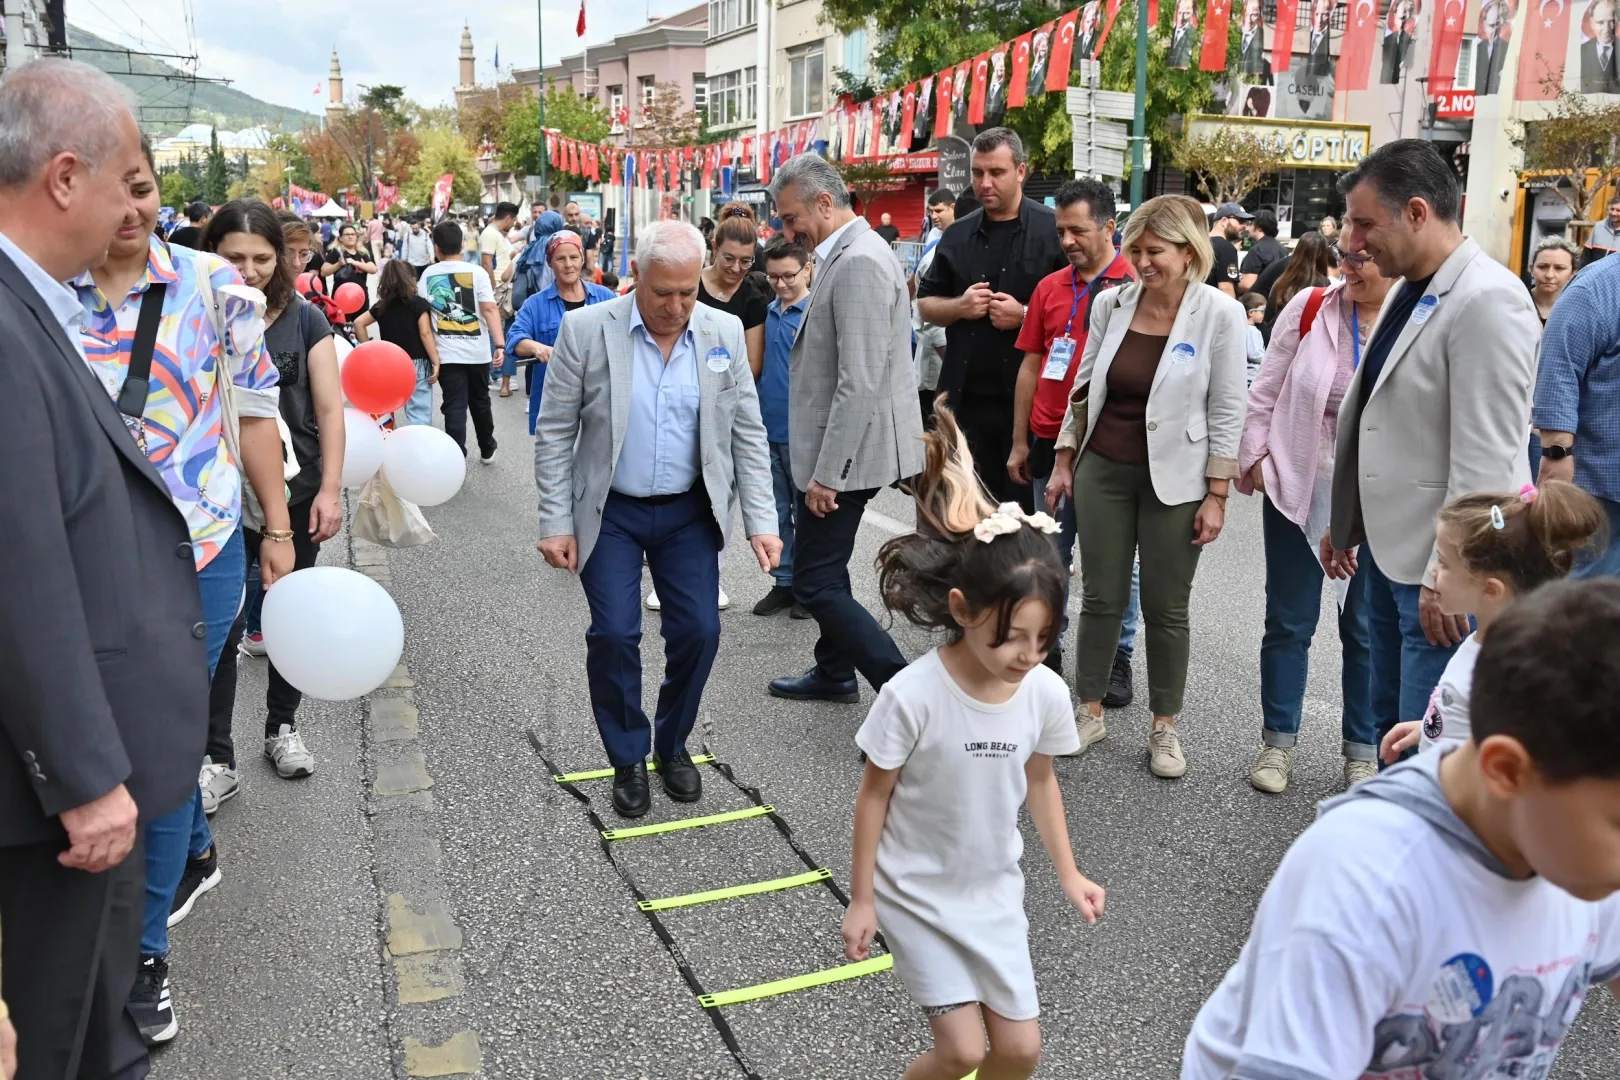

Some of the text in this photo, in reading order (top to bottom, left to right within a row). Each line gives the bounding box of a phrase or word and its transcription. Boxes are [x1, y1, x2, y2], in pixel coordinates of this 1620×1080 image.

[1288, 83, 1324, 97] CASELLI
[965, 742, 1018, 753] LONG BEACH
